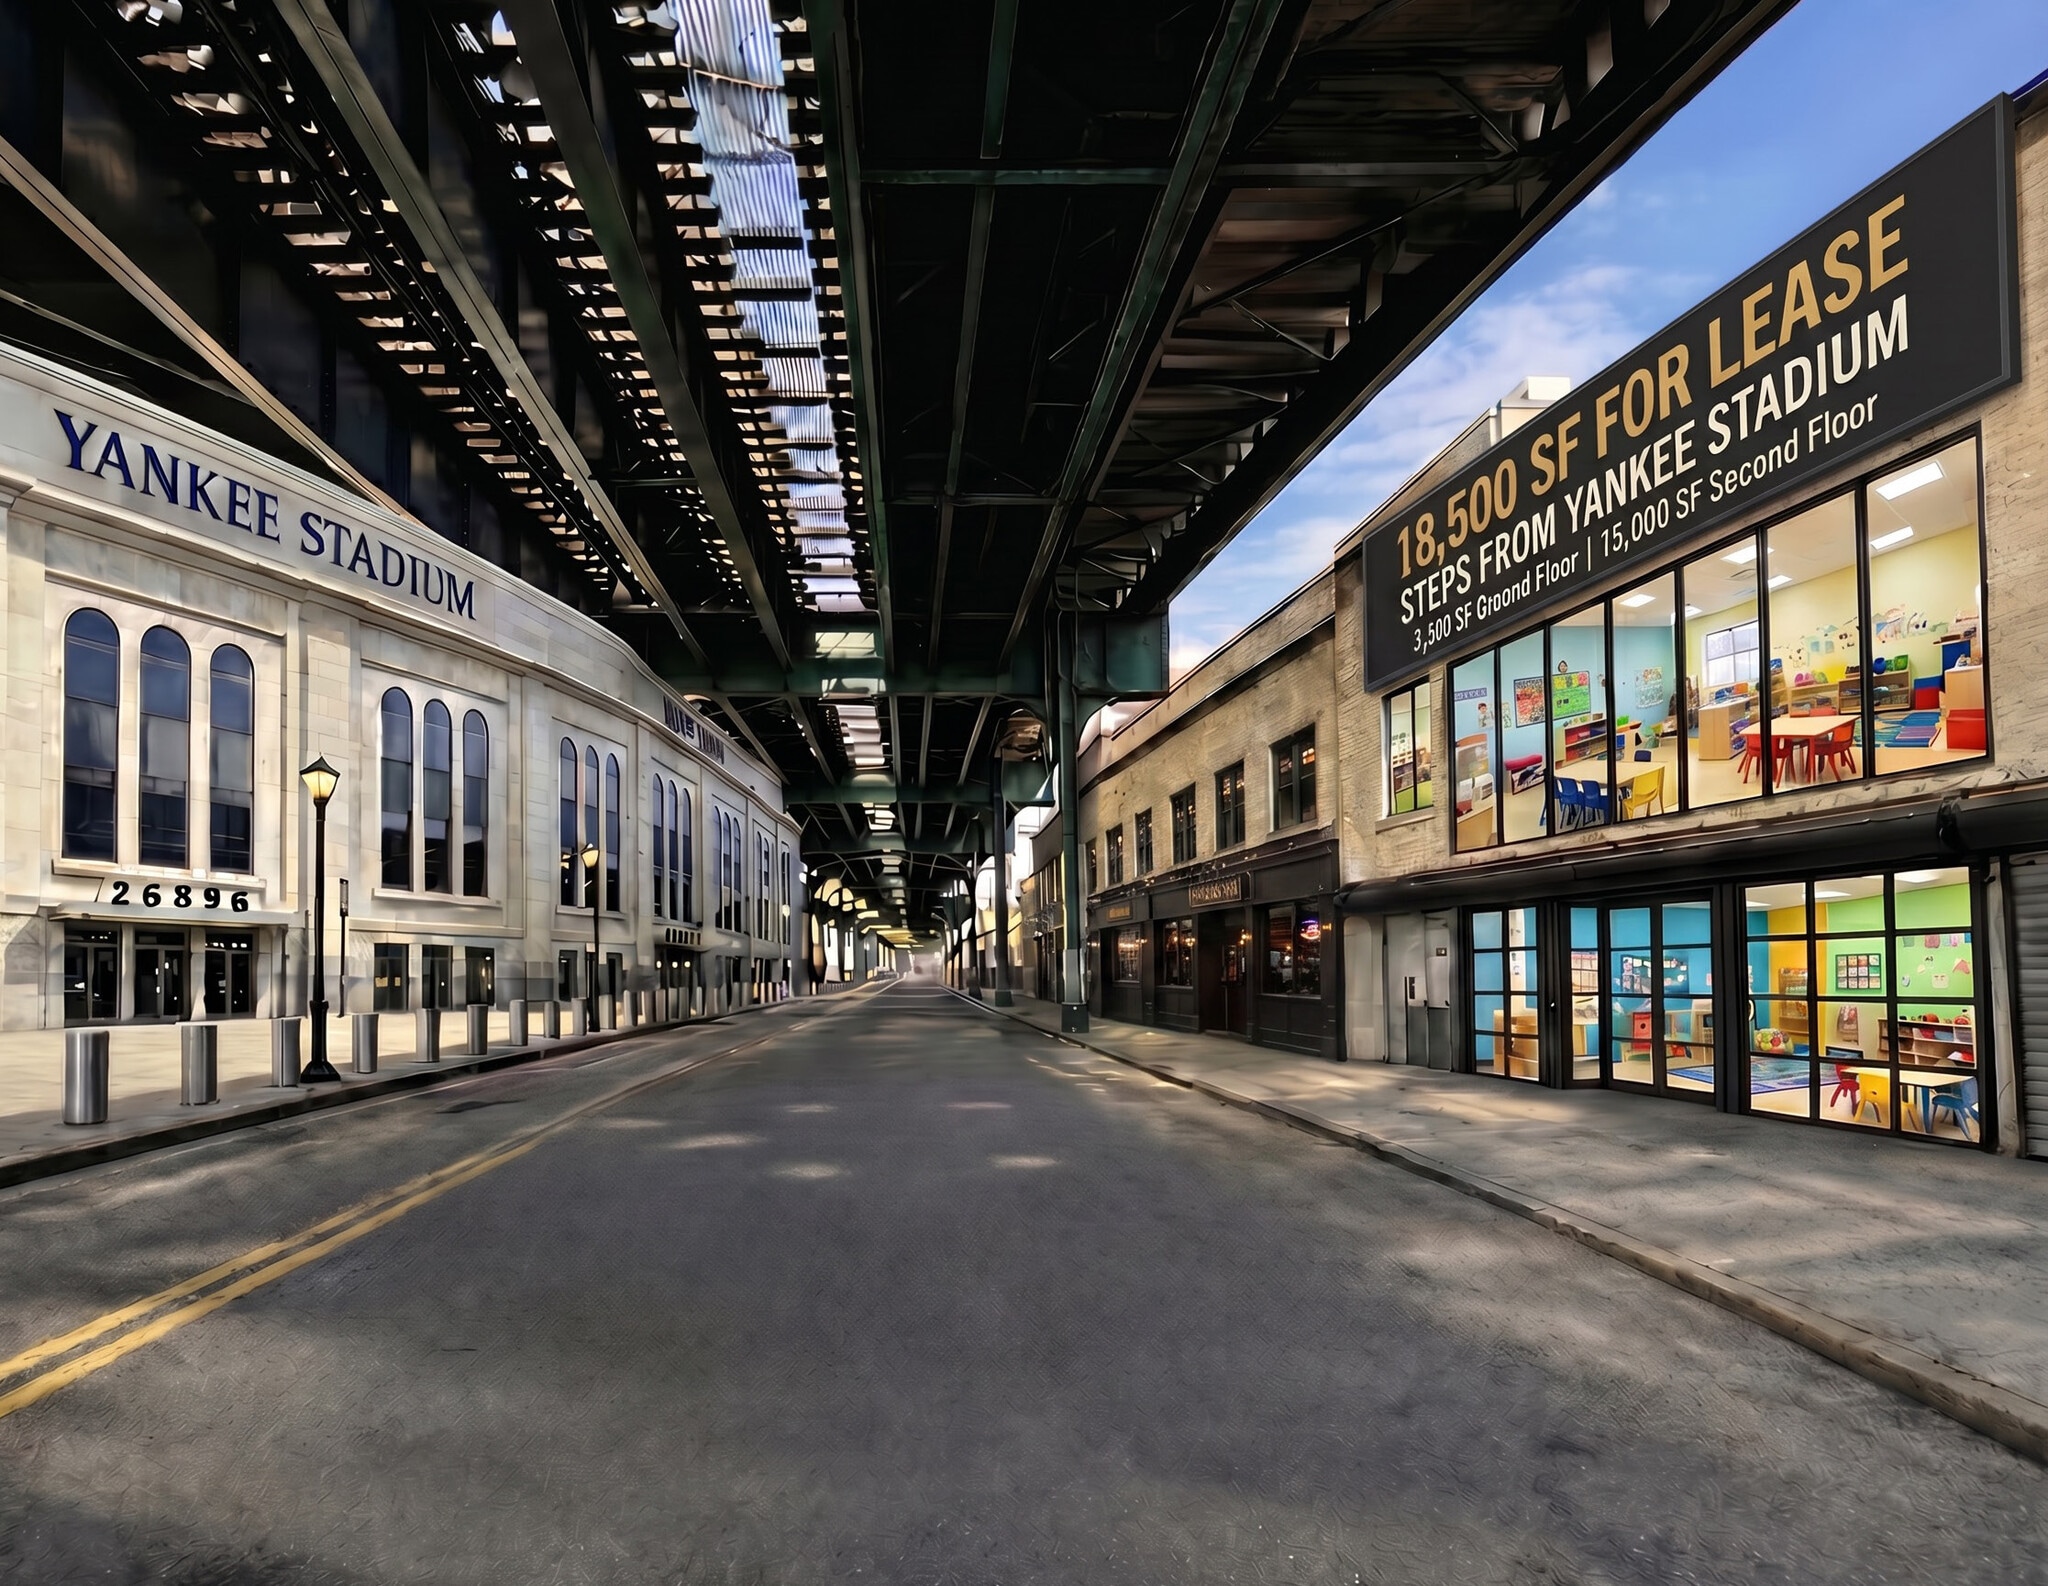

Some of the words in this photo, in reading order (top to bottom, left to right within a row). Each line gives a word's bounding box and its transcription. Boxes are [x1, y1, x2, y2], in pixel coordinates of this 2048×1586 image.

[53, 408, 281, 545] YANKEE
[300, 511, 477, 621] STADIUM
[1397, 458, 1518, 579] 18,500
[1530, 411, 1582, 496] SF
[1595, 343, 1693, 459] FOR
[1708, 193, 1909, 389] LEASE
[1400, 553, 1472, 625] STEPS
[1479, 502, 1556, 585] FROM
[1563, 418, 1697, 534] YANKEE
[1707, 293, 1909, 455] STADIUM
[1413, 613, 1452, 655] 3,500
[1454, 600, 1473, 633] SF
[1535, 551, 1579, 593] Floor
[1600, 497, 1670, 560] 15,000
[1675, 477, 1704, 520] SF
[1709, 427, 1799, 503] Second
[1808, 393, 1879, 453] Floor
[111, 880, 249, 913] 26896
